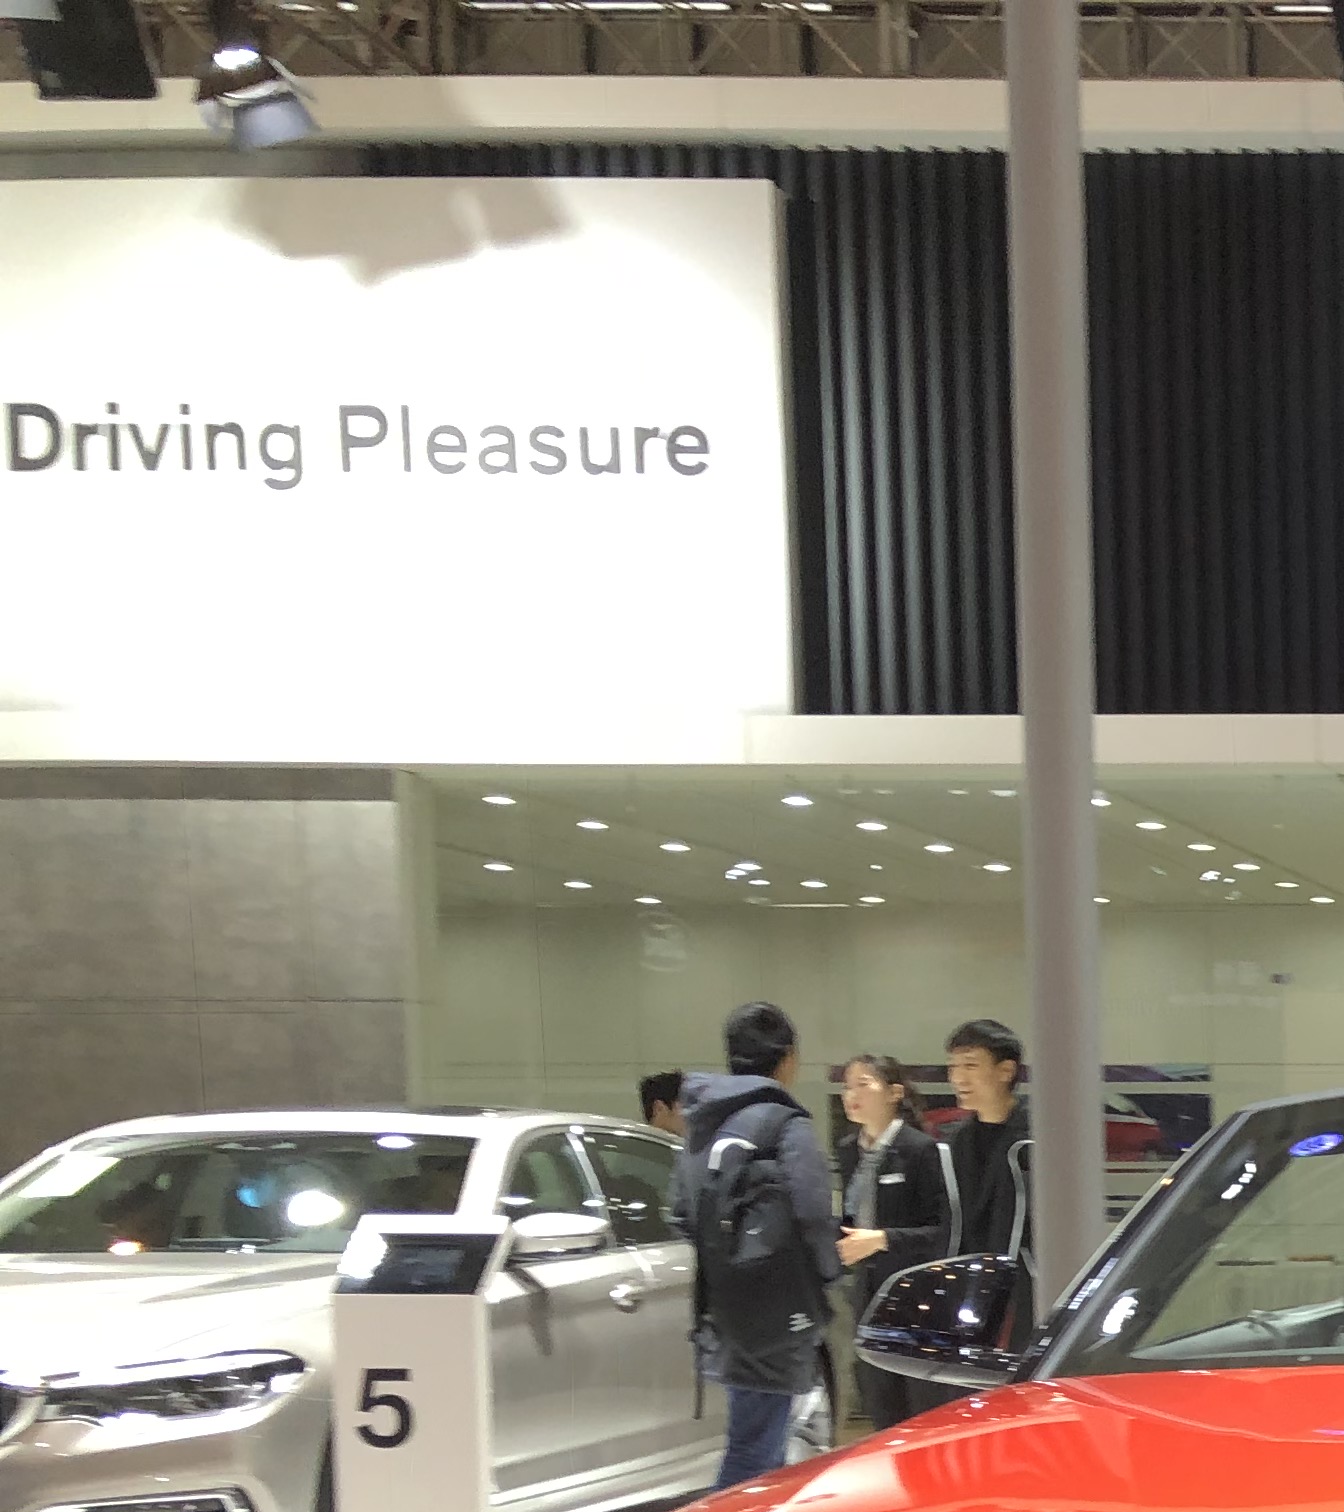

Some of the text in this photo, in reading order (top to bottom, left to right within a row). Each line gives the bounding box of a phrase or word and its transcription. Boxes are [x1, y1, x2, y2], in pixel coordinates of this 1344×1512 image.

[3, 401, 711, 491] Driving Pleasure
[355, 1366, 416, 1449] 5
